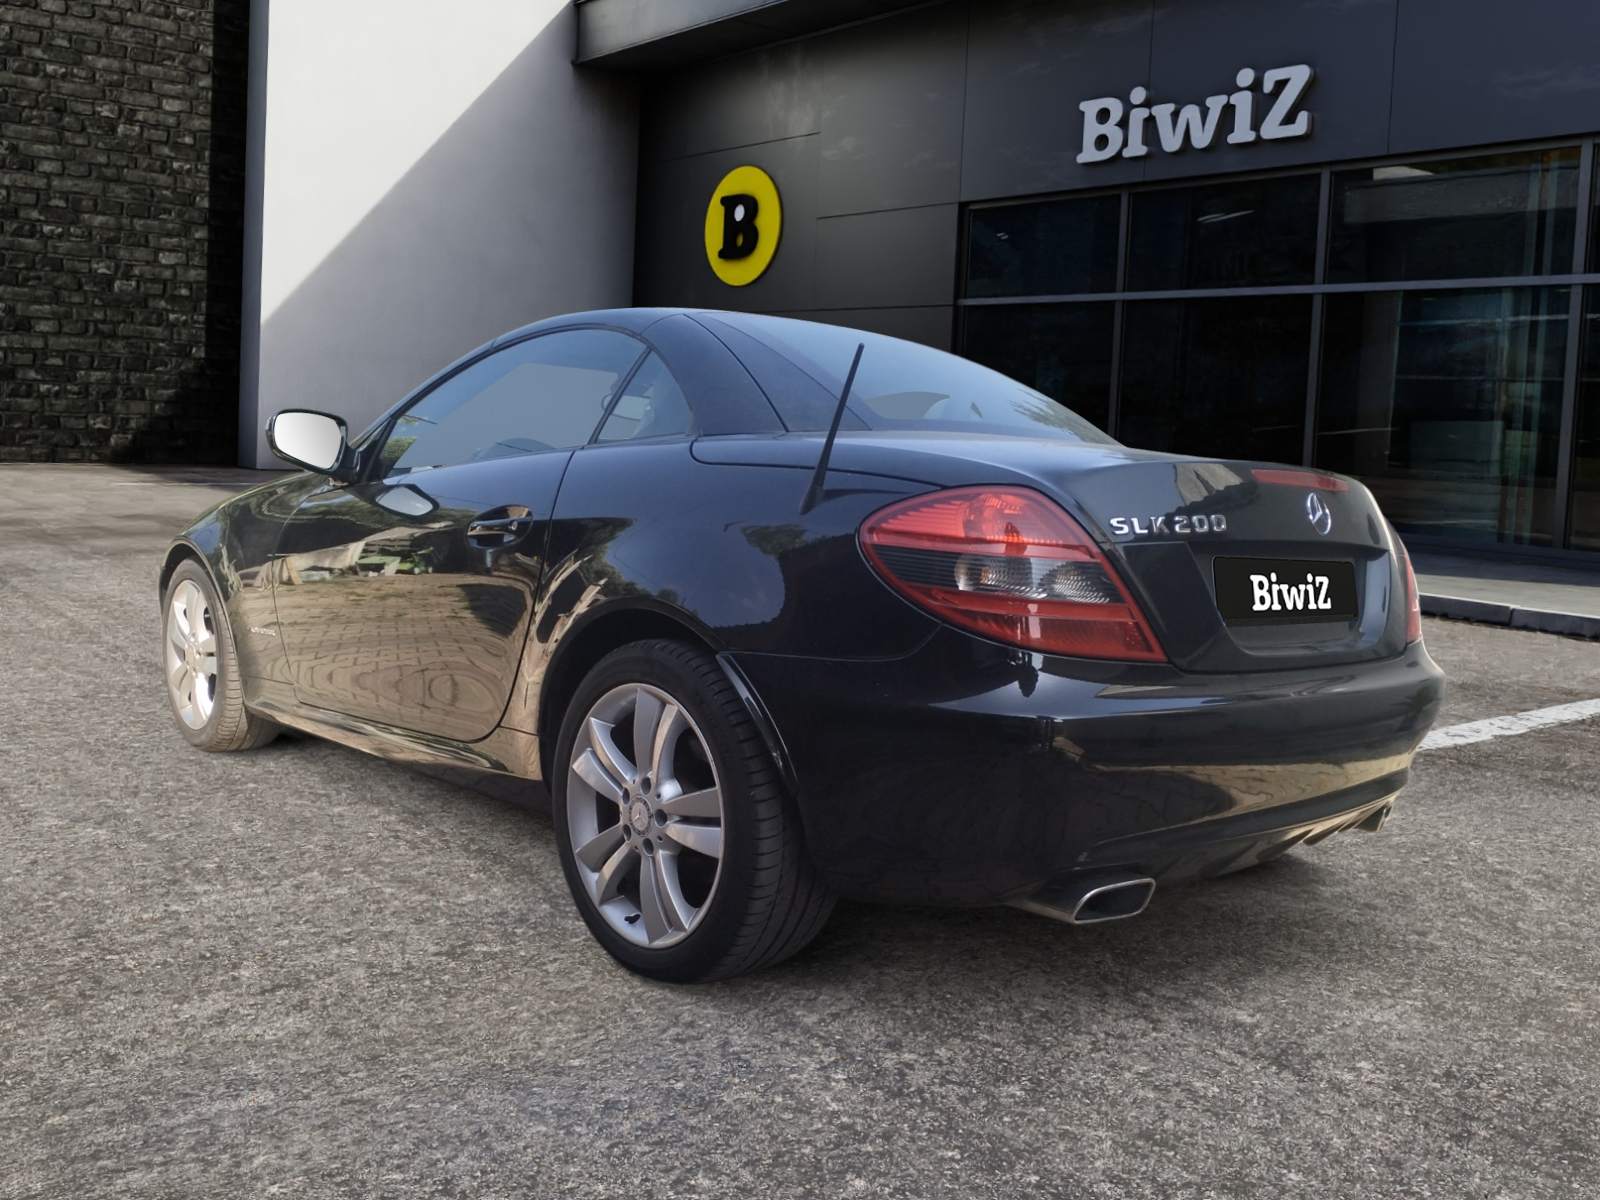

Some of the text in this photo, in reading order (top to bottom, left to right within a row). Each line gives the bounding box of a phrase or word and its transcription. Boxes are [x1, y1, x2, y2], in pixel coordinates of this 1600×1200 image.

[1076, 64, 1312, 164] BiwiZ
[718, 193, 759, 260] B
[1109, 514, 1227, 535] SLK 200
[1249, 572, 1332, 611] BiwiZ
